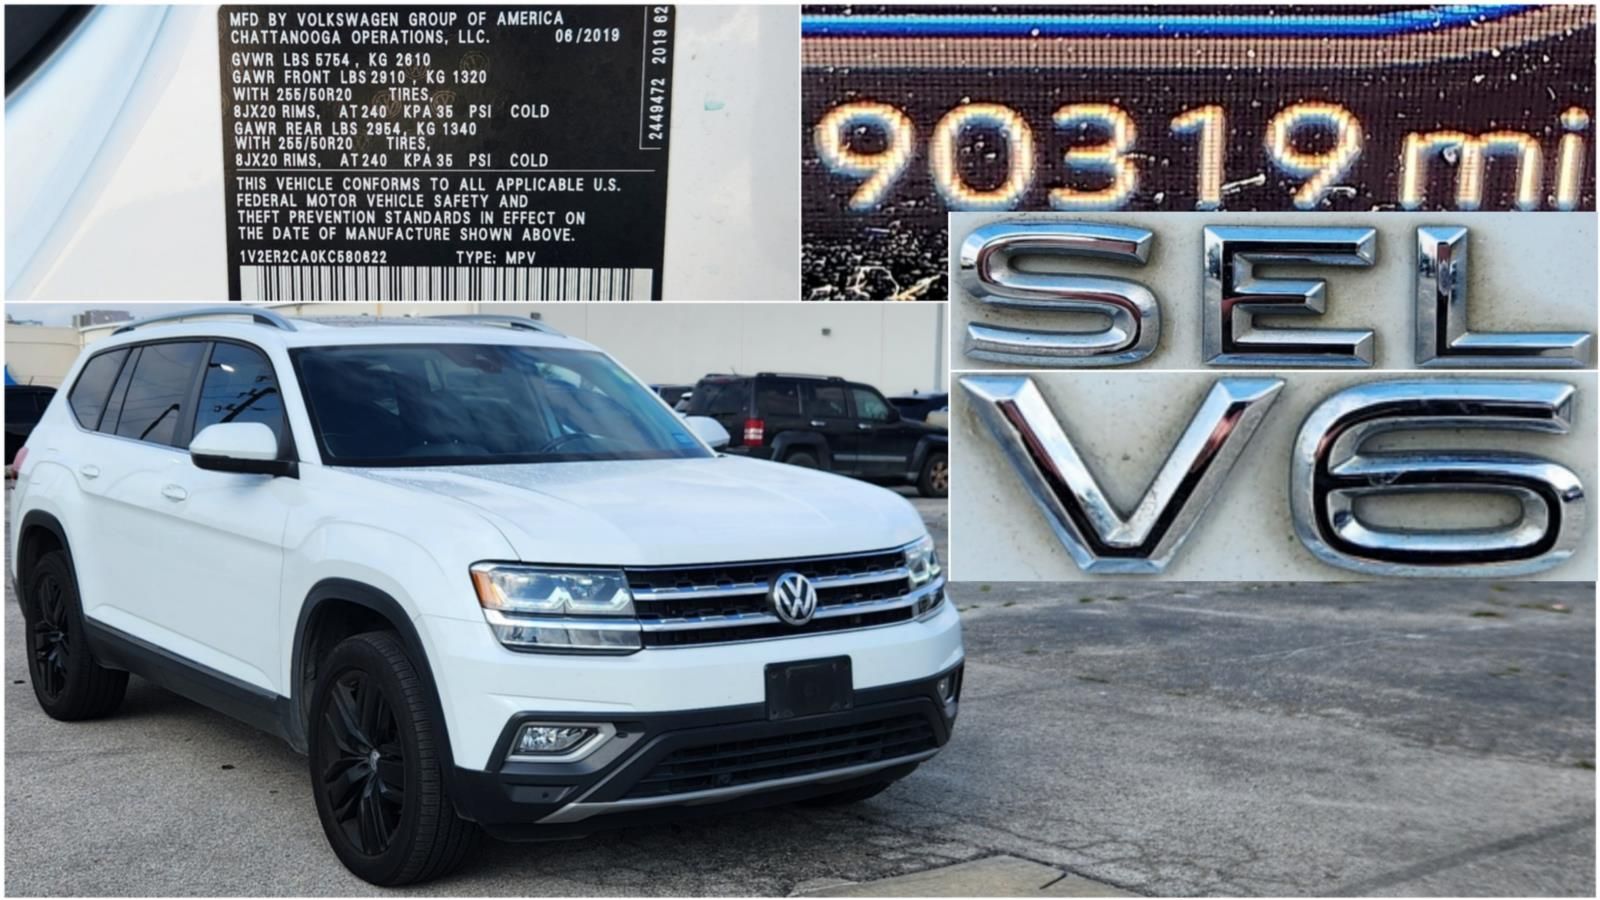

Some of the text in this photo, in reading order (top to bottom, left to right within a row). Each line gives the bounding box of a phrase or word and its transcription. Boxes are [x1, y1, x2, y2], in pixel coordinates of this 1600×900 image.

[229, 11, 564, 28] MFD BY VOLKSWAGEN GROUP OF AMERICA
[230, 29, 490, 46] CHATTANOOGA OPERATIONS, LLC.
[651, 30, 668, 65] 2019
[231, 52, 275, 68] GVWR
[283, 53, 310, 67] LBS
[368, 53, 388, 67] KG
[395, 53, 431, 67] 2610
[231, 69, 275, 85] GAWR
[284, 70, 331, 85] FRONT
[340, 70, 367, 85] LBS
[426, 70, 446, 85] KG
[452, 70, 487, 84] 1320
[232, 87, 270, 102] WITH
[276, 88, 353, 102] 255/50R20
[388, 87, 434, 104] TIRES,
[233, 104, 277, 119] 8JX20
[281, 105, 321, 120] RIMS,
[403, 104, 433, 119] KPA
[435, 105, 454, 119] 35
[469, 104, 492, 119] PSI
[510, 104, 550, 119] COLD
[648, 79, 666, 140] 2449472
[233, 121, 277, 136] GAWR
[285, 122, 323, 136] REAR
[331, 122, 358, 136] LBS
[416, 122, 436, 136] KG
[442, 122, 477, 136] 1340
[234, 135, 431, 152] WITH 255/50R20 TIRES,
[235, 153, 278, 167] 8JX20
[283, 153, 322, 169] RIMS,
[403, 153, 432, 168] KPA
[436, 154, 453, 168] 35
[468, 153, 491, 168] PSI
[509, 153, 549, 168] COLD
[815, 102, 1590, 211] 90319 mi
[235, 177, 621, 192] THIS VEHICLE CONFORMS TO ALL APPLICABLE U.S.
[236, 193, 529, 209] FEDERAL MOTOR VEHICLE SAFETY AND
[237, 210, 586, 225] THEFT PREVENTION STANDARDS IN EFFECT ON
[237, 227, 575, 242] THE DATE OF MANUFACTURE SHOWN ABOVE.
[455, 251, 497, 265] TYPE:
[505, 251, 536, 265] MPV
[957, 220, 1592, 368] SEL
[957, 374, 1587, 577] V6
